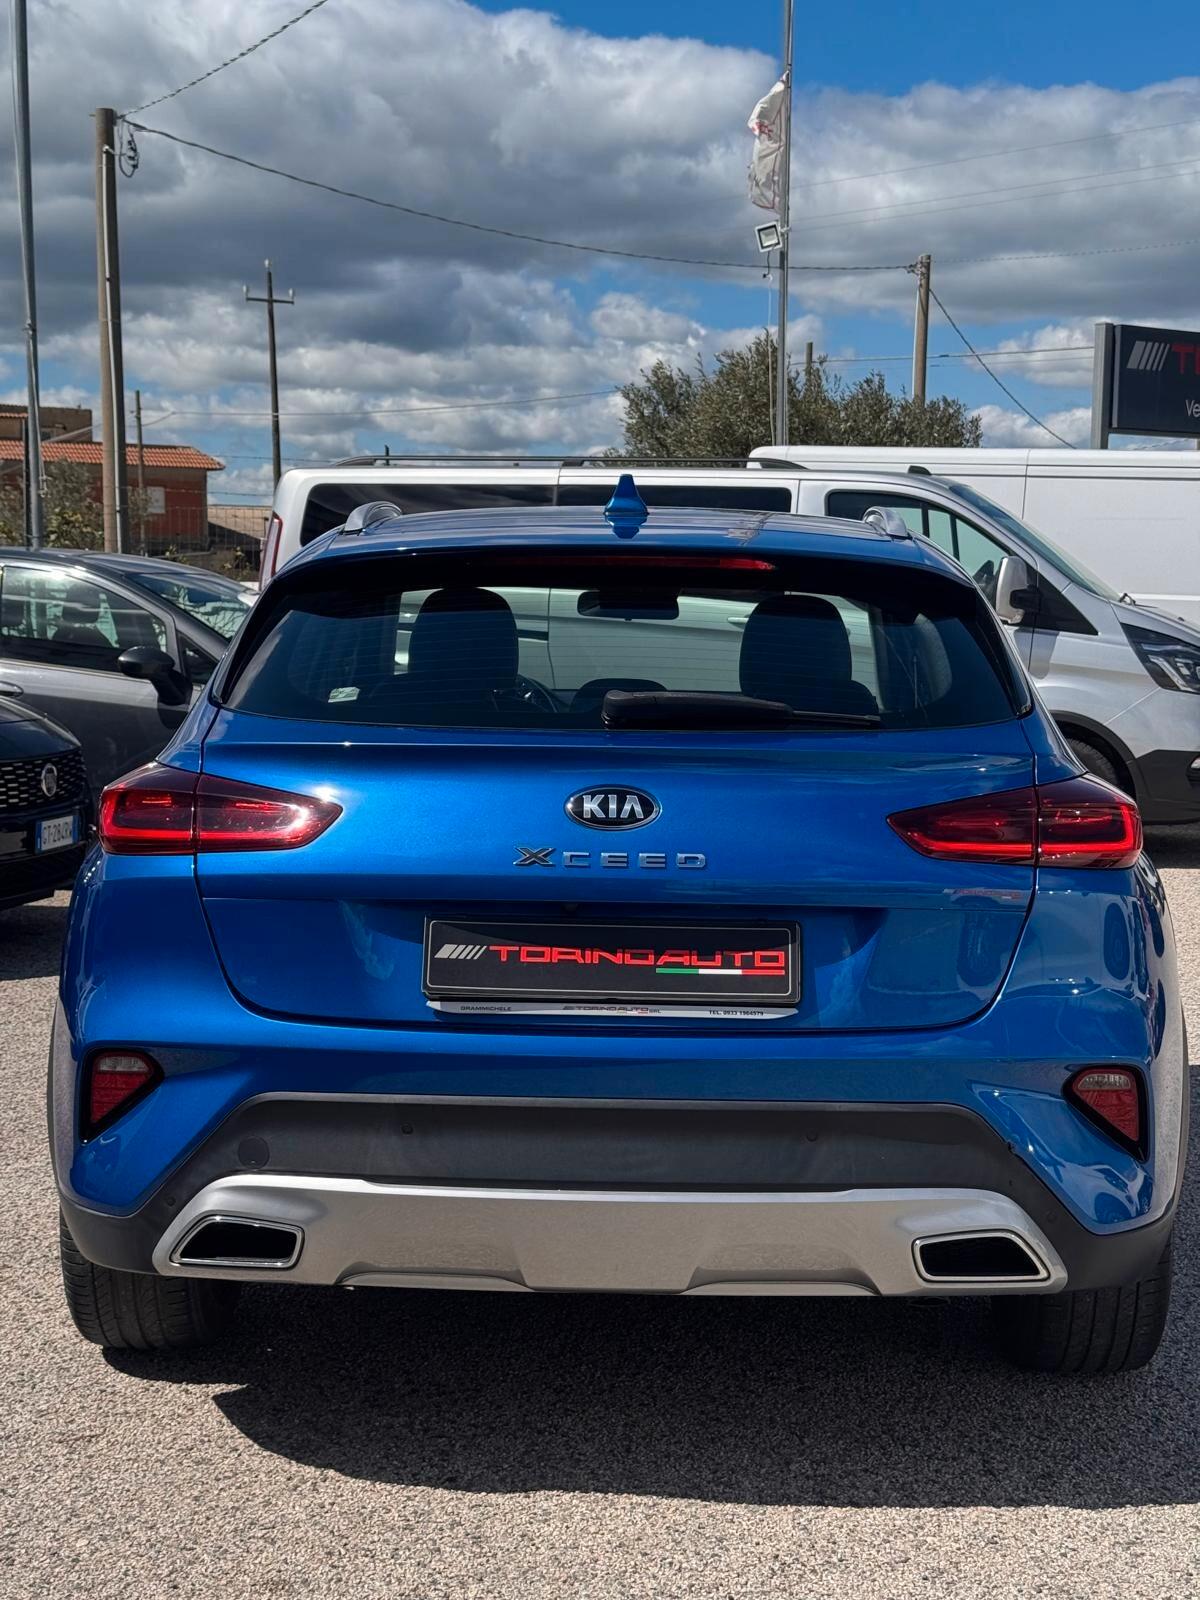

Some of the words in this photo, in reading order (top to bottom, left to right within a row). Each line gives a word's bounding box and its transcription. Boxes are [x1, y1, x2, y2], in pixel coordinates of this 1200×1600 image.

[1171, 343, 1200, 375] T
[582, 794, 644, 819] KIA
[513, 847, 706, 868] XCEED
[489, 945, 785, 967] TORINOAUTO
